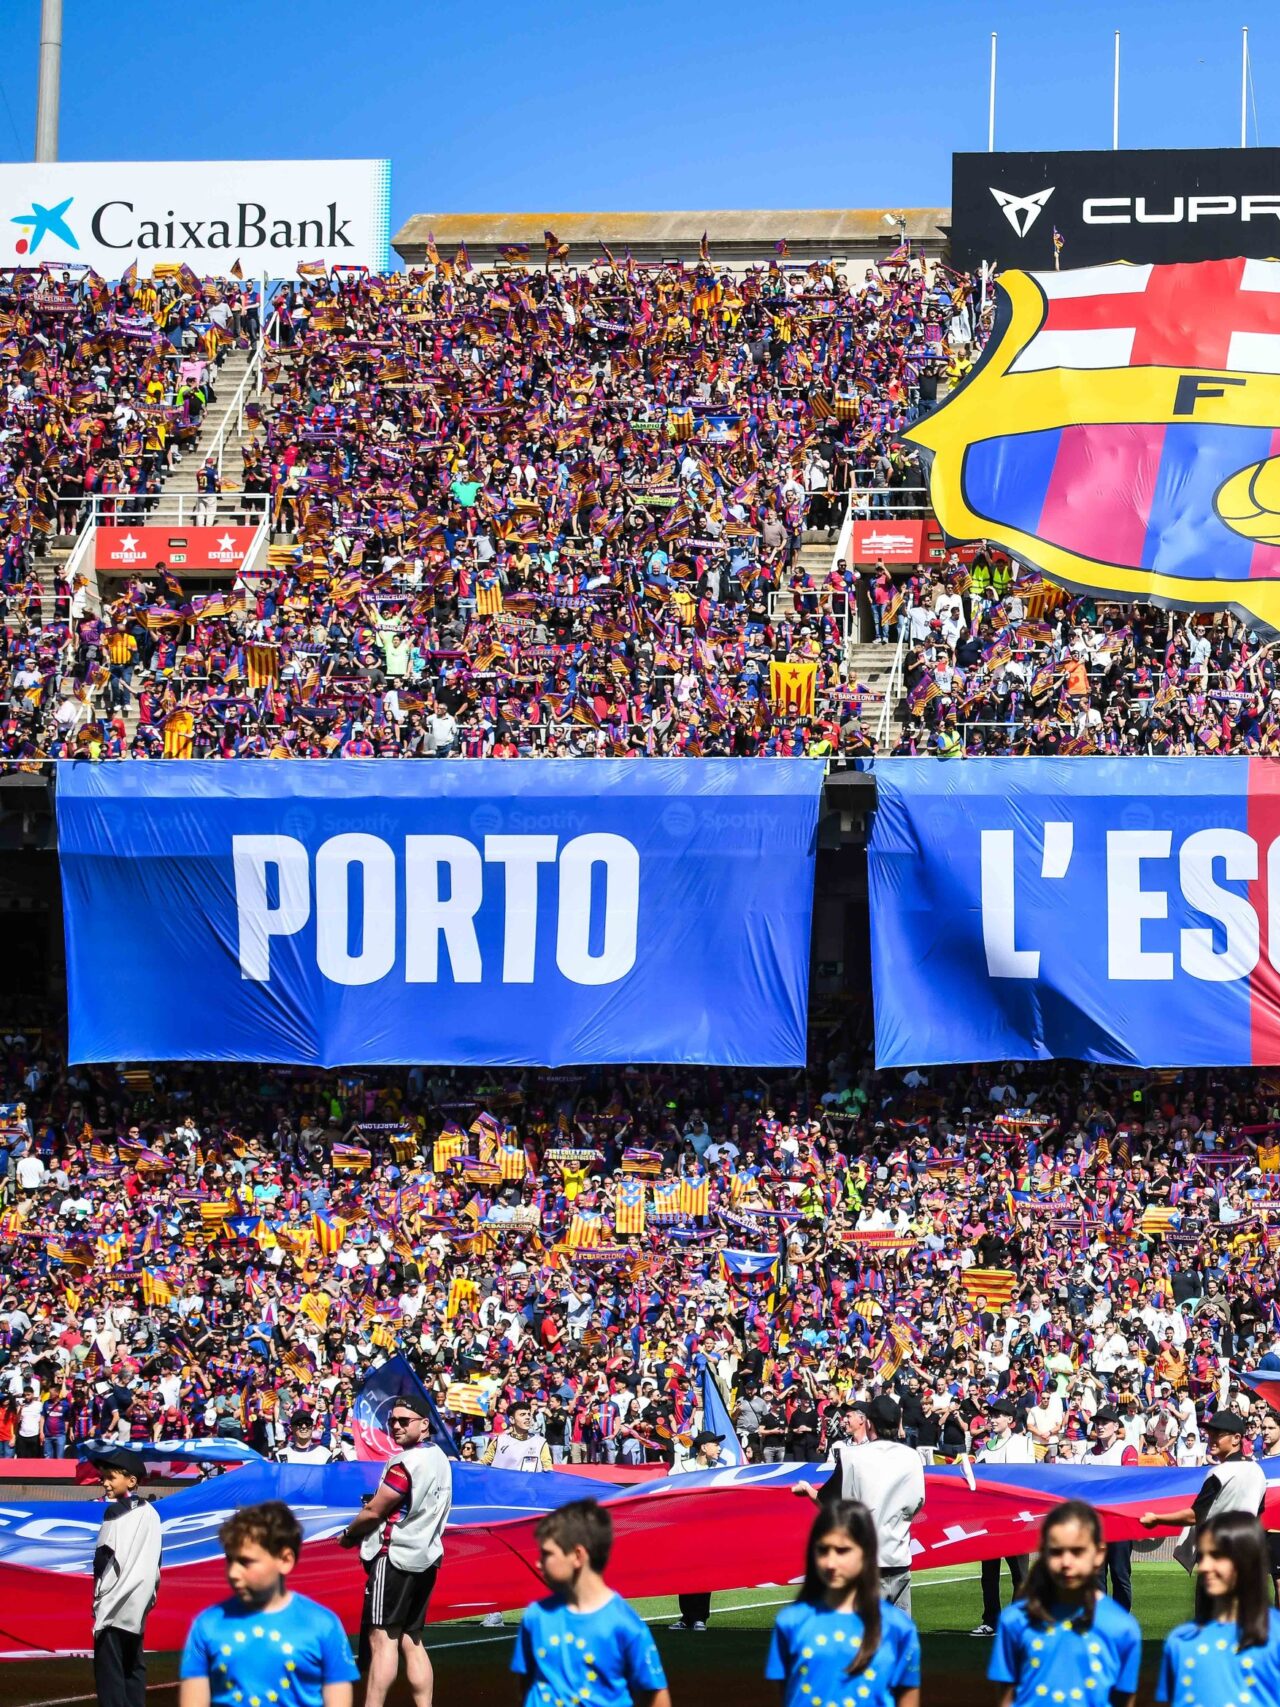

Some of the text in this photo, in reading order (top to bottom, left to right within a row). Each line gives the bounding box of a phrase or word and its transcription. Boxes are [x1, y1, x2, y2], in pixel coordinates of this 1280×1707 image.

[91, 200, 353, 249] CaixaBank
[838, 693, 875, 702] BARCELONA
[509, 808, 588, 833] Spotify
[699, 808, 779, 832] Spotify
[231, 832, 640, 986] PORTO
